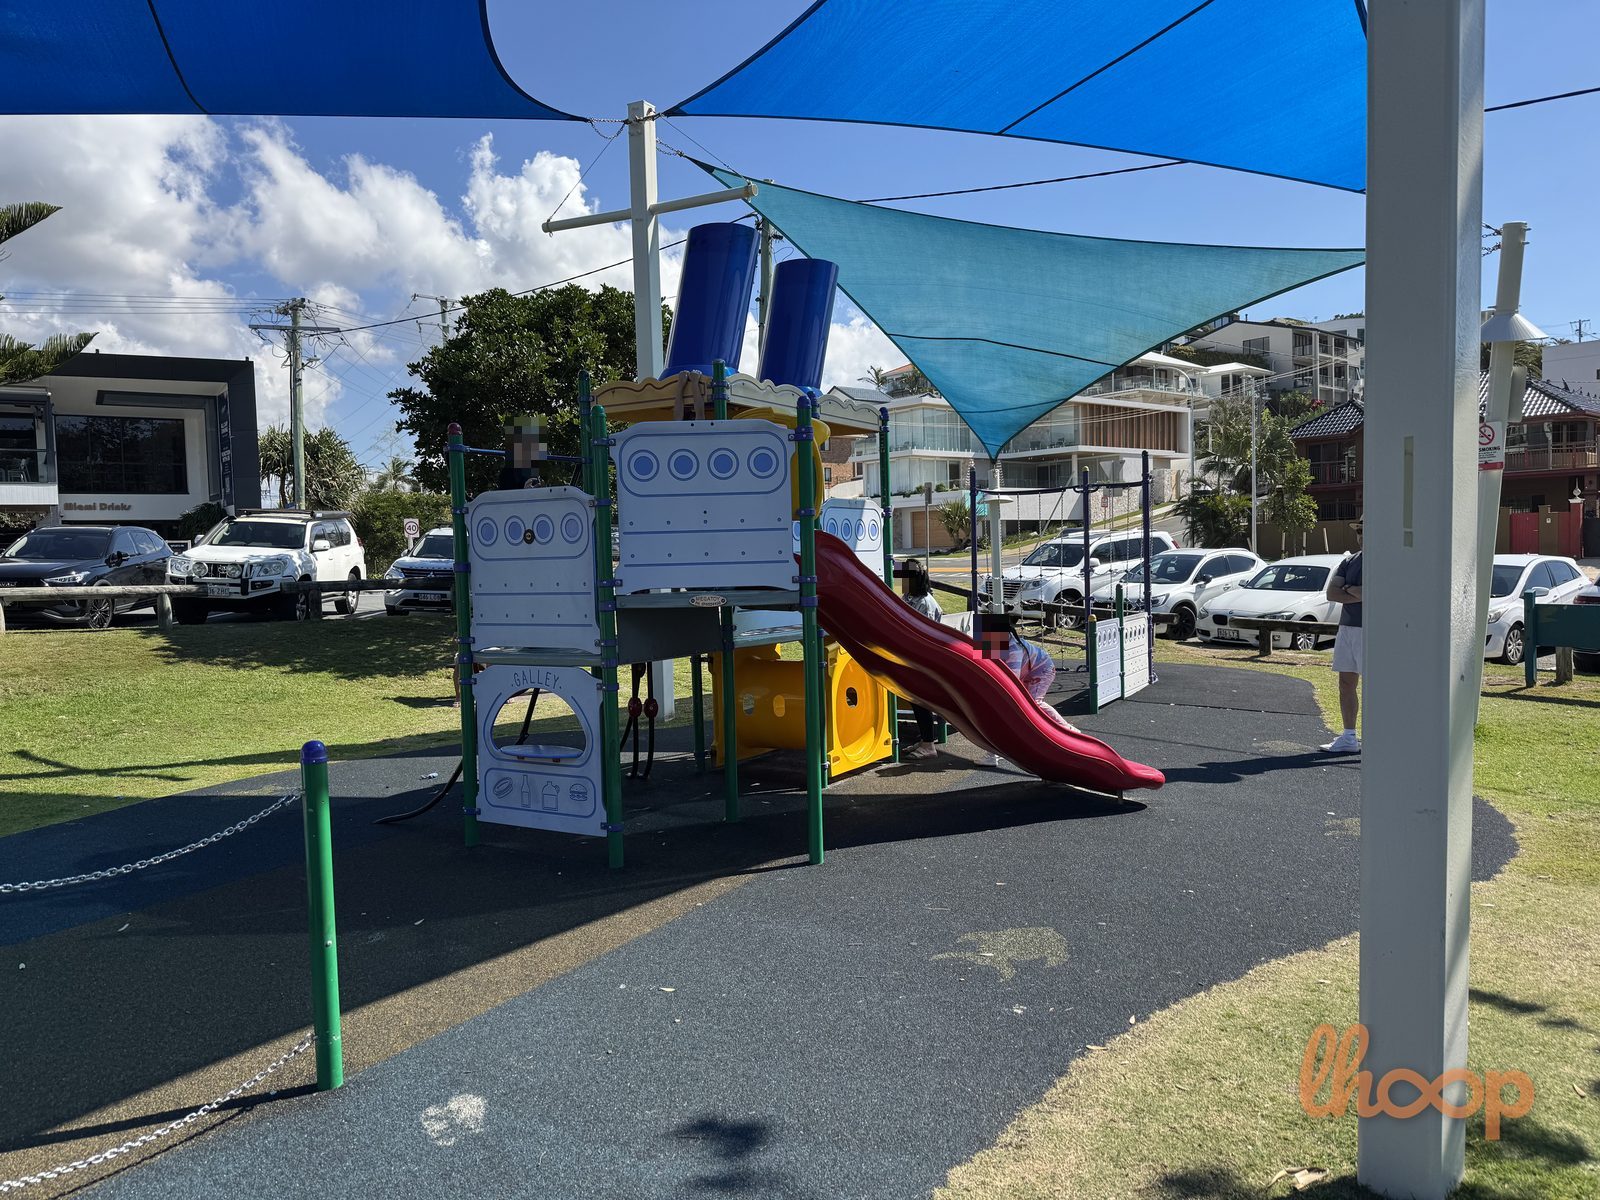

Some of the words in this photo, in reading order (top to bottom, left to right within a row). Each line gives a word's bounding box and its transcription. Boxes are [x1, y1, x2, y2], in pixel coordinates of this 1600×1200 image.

[99, 502, 132, 511] Drinks
[406, 524, 417, 532] 40
[513, 669, 560, 690] GALLEY
